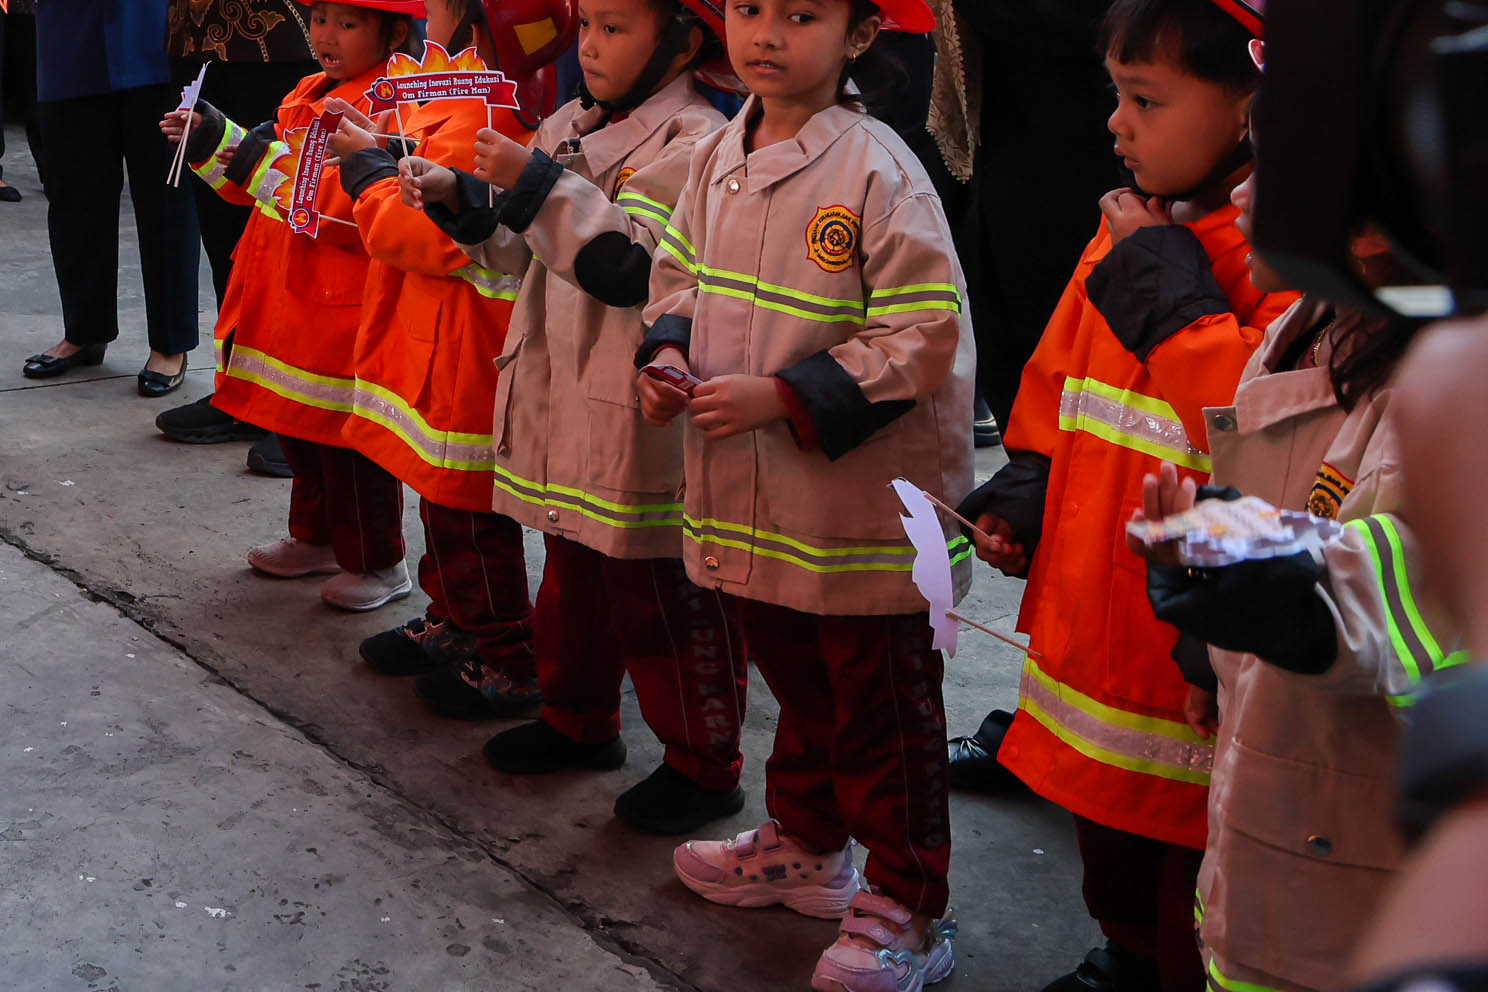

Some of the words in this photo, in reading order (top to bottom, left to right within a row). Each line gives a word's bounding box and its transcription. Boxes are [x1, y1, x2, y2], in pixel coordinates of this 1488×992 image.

[396, 79, 427, 90] Launching
[428, 77, 452, 87] Inovasi
[453, 76, 473, 87] Ruang
[474, 74, 500, 84] Edukasi
[401, 91, 416, 99] Om
[417, 87, 448, 98] Firman
[449, 87, 469, 96] (Fire
[470, 86, 491, 95] Man)
